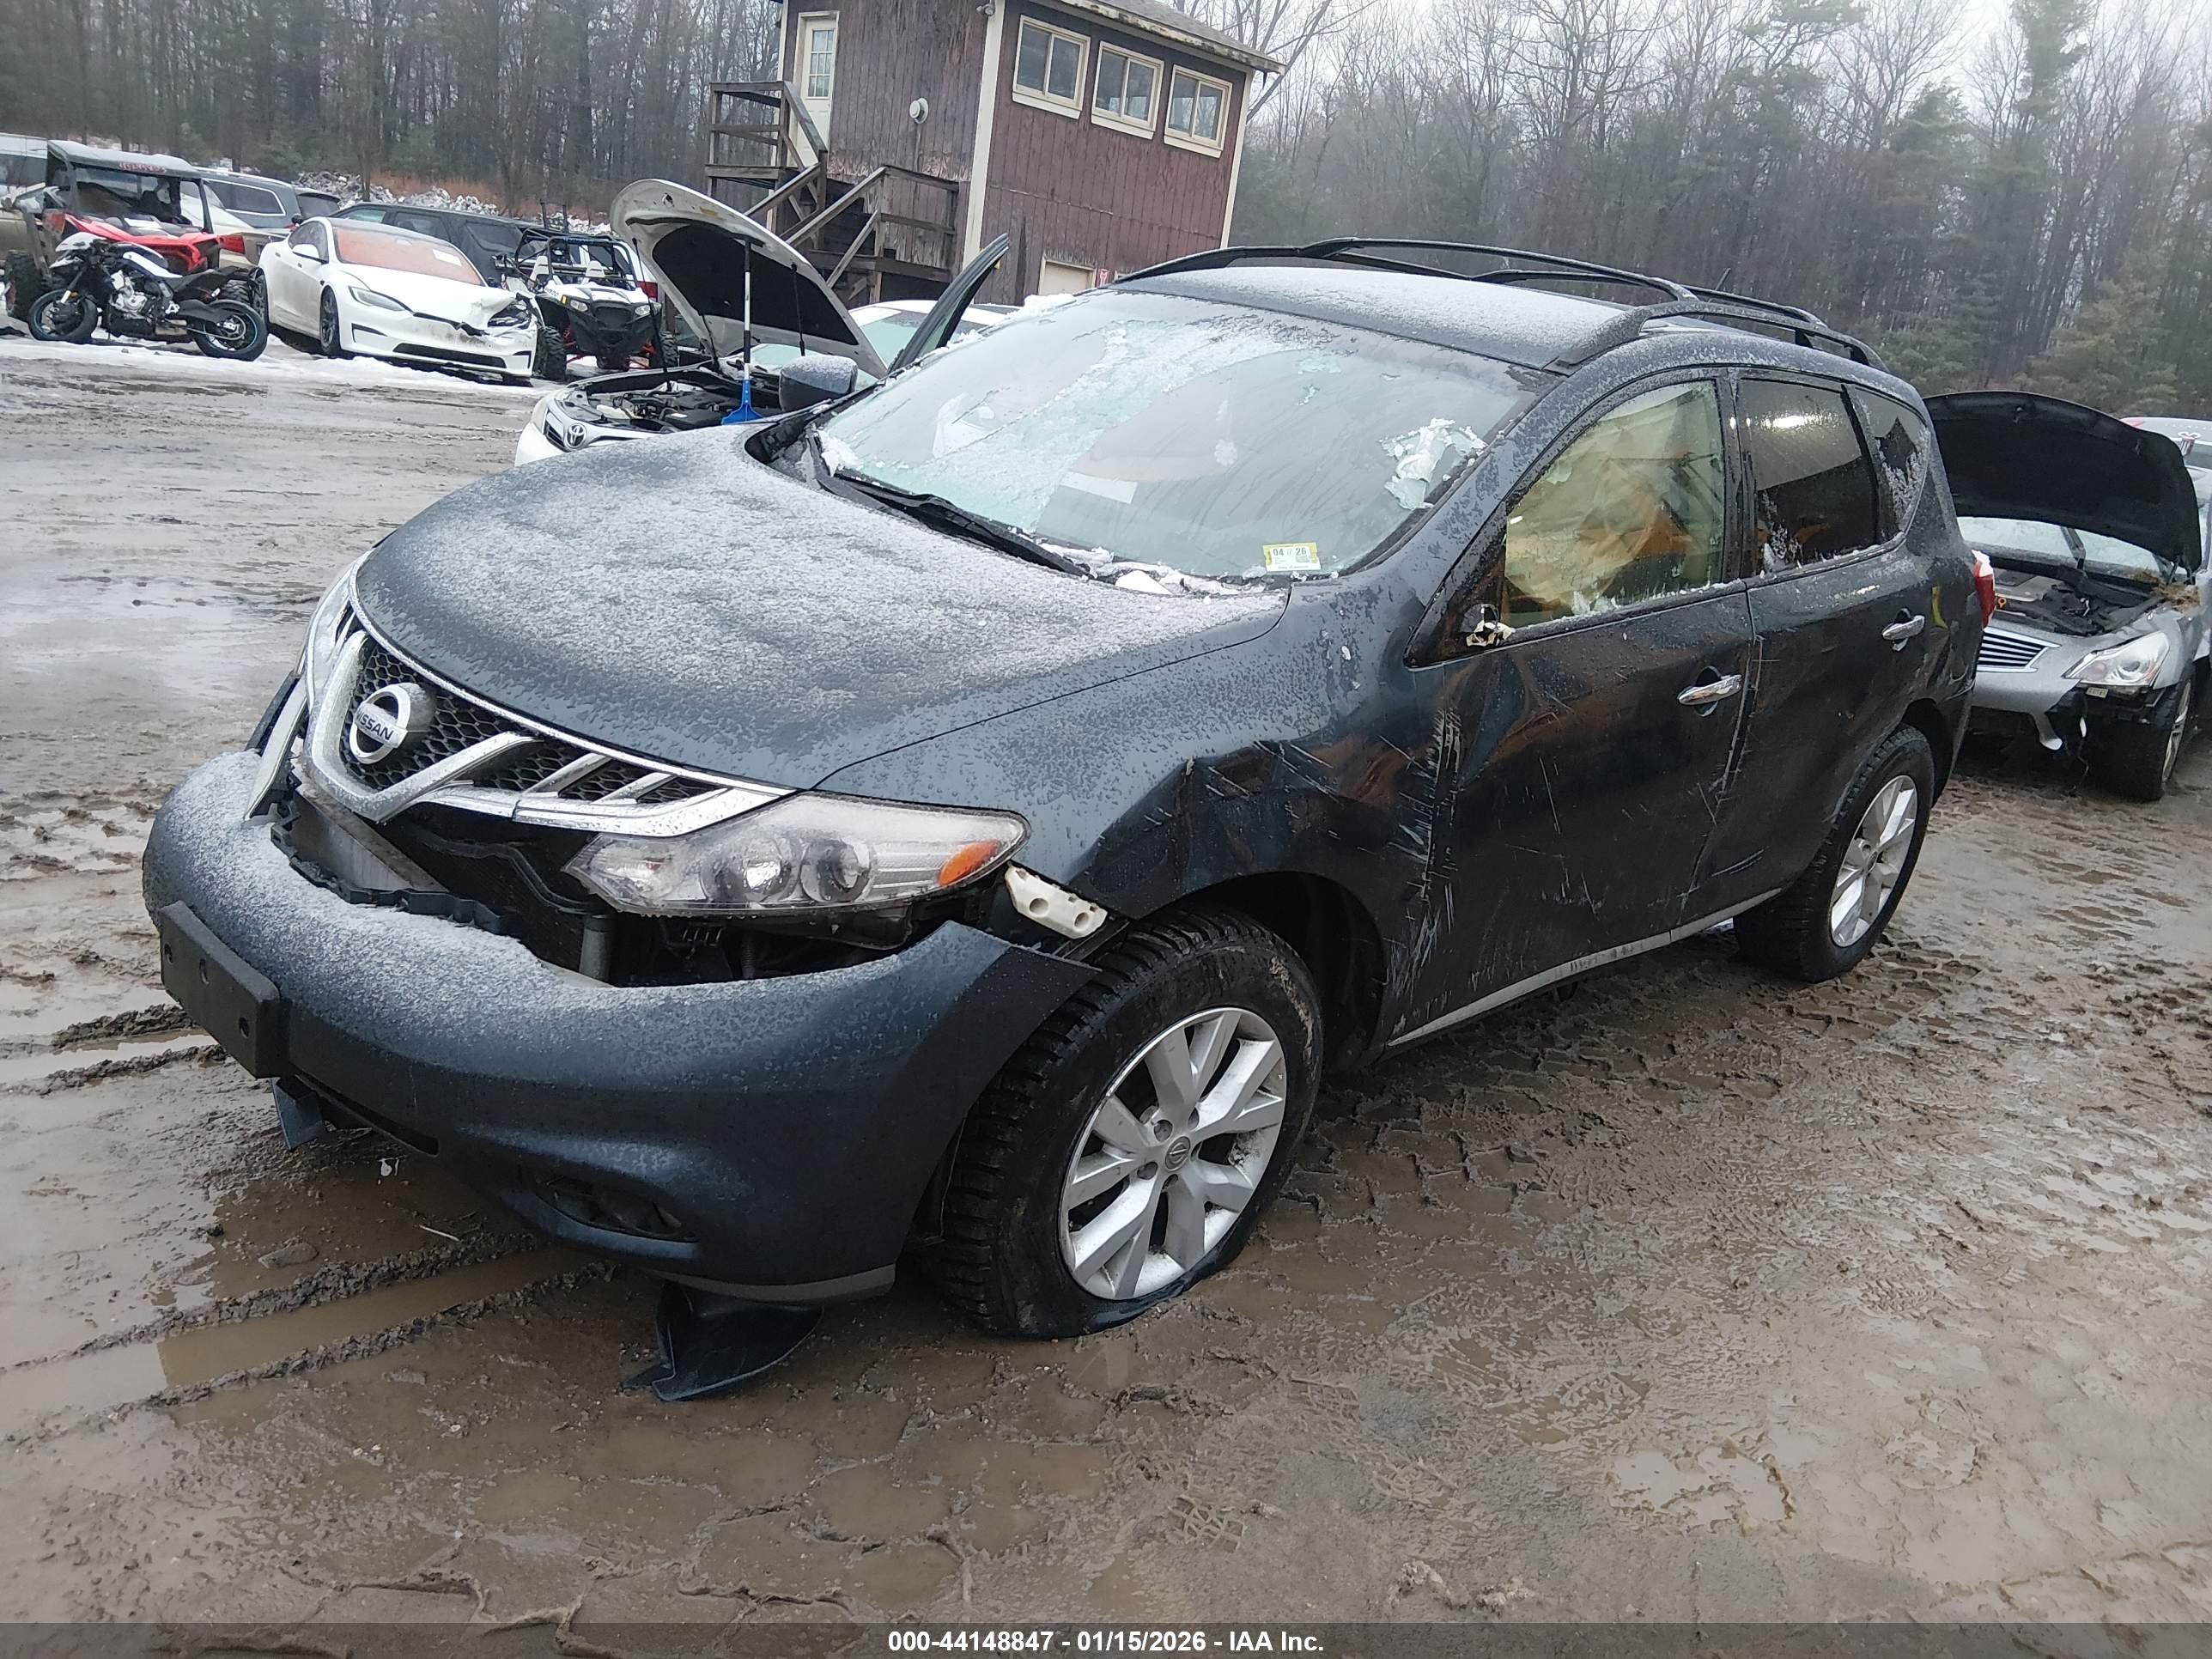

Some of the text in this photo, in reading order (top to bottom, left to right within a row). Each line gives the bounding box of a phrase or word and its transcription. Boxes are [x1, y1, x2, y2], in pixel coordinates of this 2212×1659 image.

[1273, 547, 1307, 556] 04 26
[356, 710, 394, 741] NISSAN
